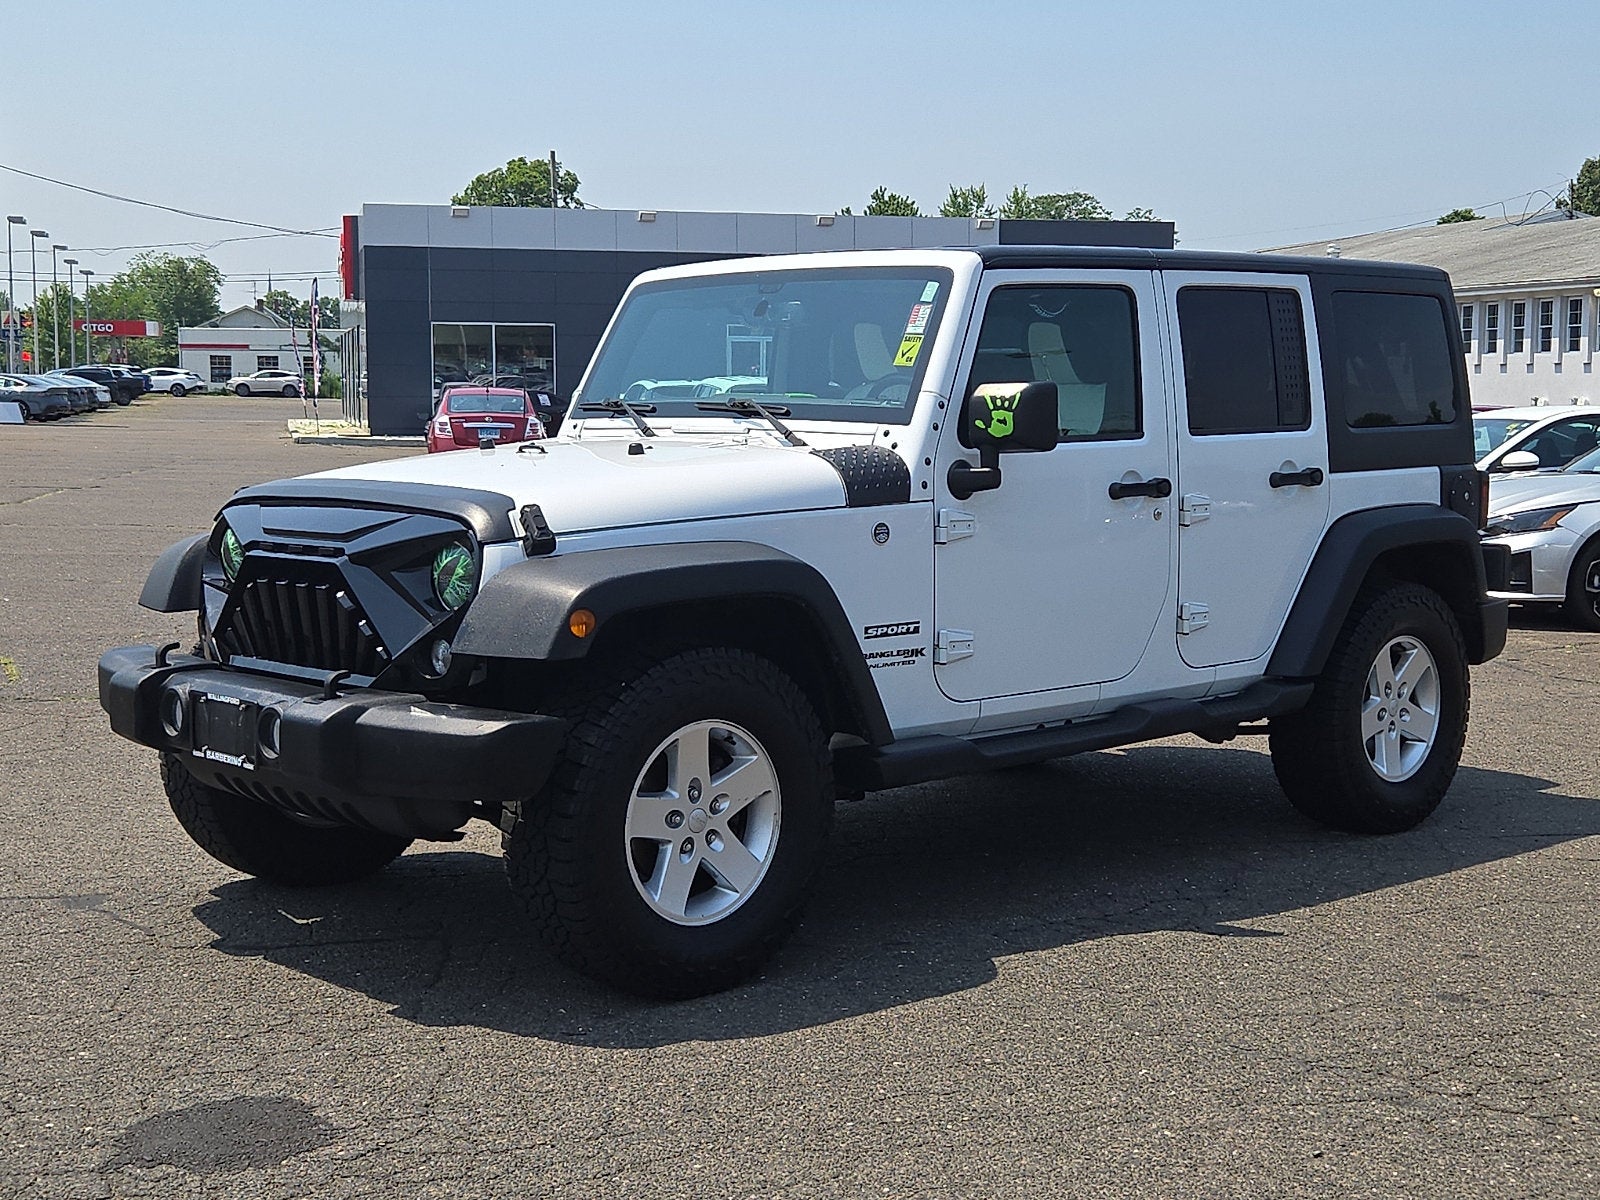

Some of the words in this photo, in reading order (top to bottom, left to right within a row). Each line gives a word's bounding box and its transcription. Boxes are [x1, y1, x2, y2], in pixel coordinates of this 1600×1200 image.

[904, 335, 922, 343] SAFETY
[867, 624, 919, 636] SPORT
[867, 660, 916, 669] NLIMITED
